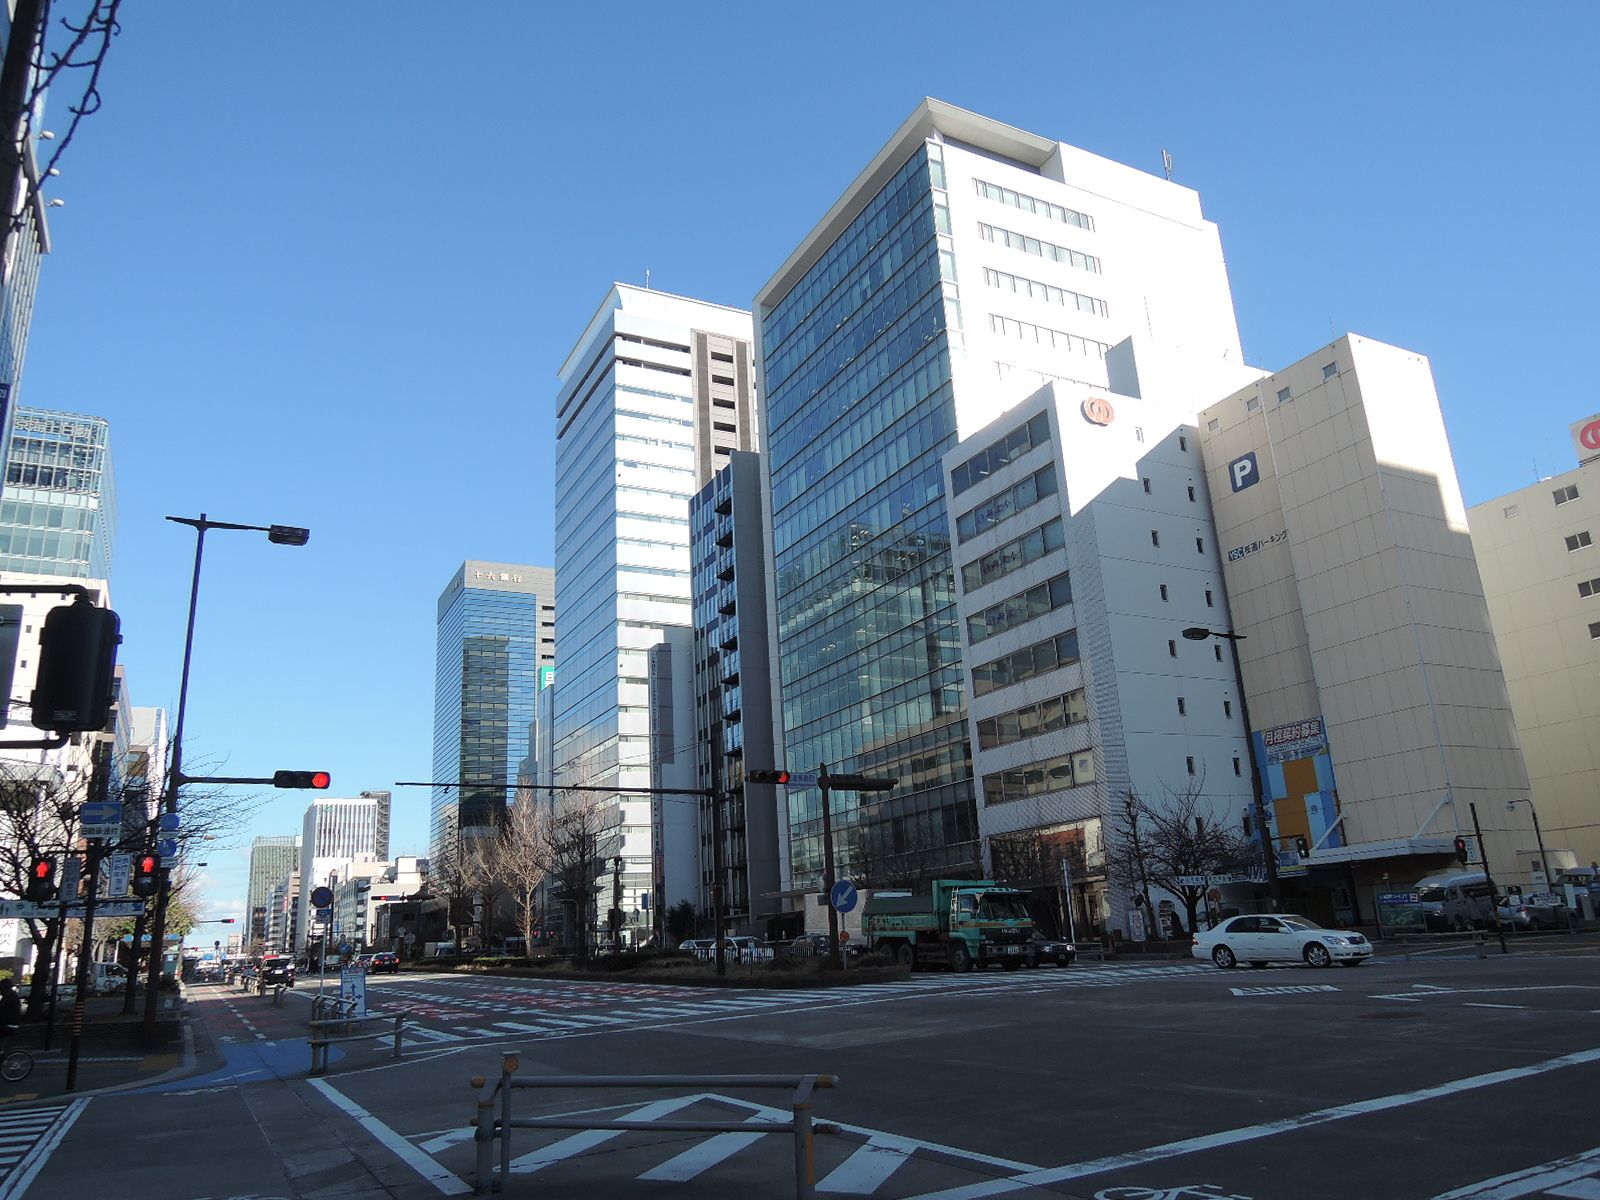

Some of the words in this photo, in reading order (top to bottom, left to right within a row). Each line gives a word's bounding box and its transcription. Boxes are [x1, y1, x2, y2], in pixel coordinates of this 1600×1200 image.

[1233, 459, 1252, 488] P
[474, 570, 523, 584] 十六銀行
